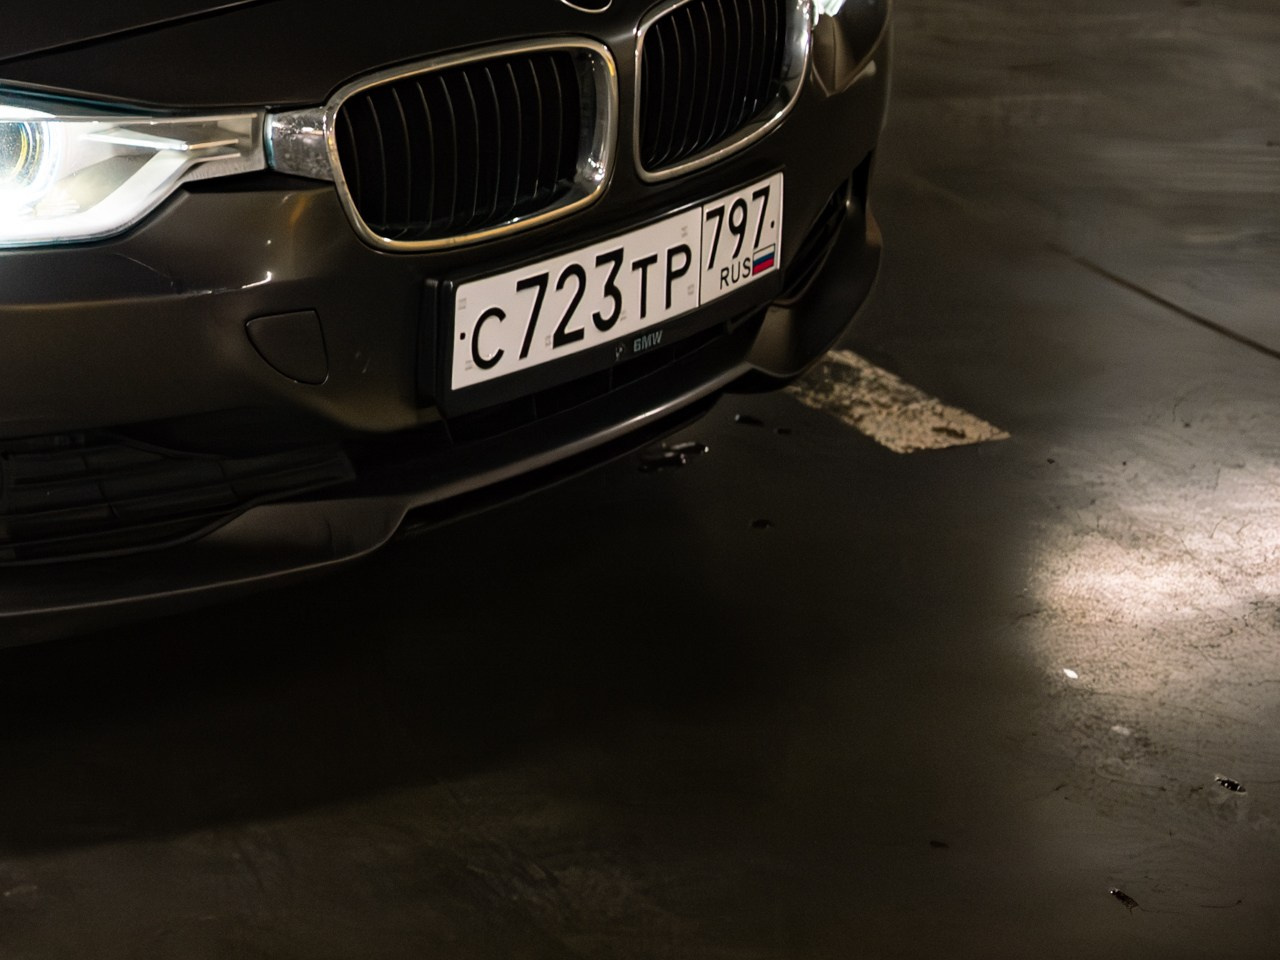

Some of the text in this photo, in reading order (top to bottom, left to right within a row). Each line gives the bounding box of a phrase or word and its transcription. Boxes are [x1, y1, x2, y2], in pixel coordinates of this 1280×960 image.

[471, 185, 771, 370] C723TP 797
[720, 258, 752, 290] RUS
